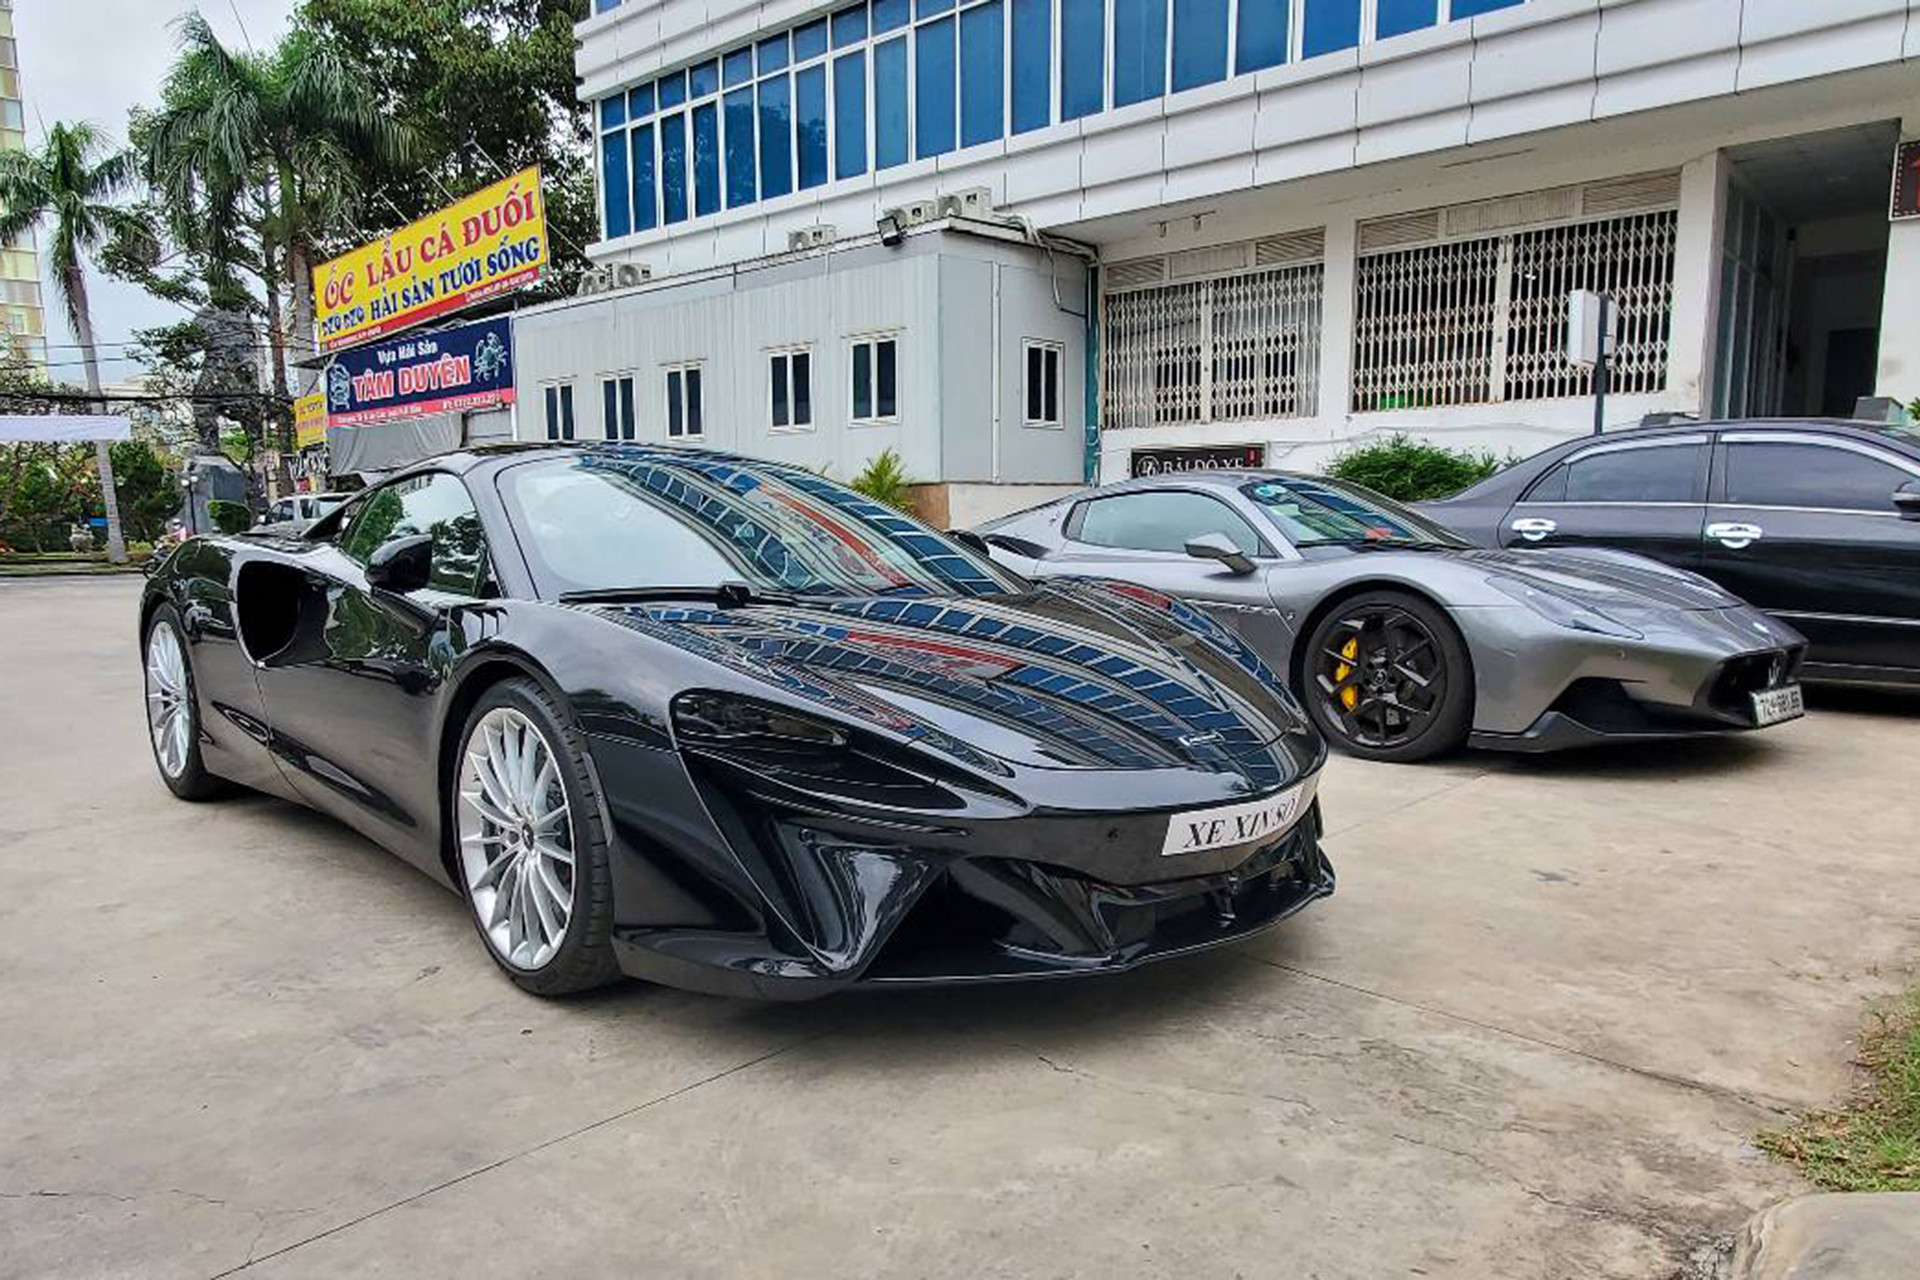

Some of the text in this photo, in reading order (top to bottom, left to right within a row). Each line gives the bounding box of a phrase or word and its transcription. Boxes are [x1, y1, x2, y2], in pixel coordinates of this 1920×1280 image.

[419, 223, 455, 263] CÁ
[462, 183, 535, 247] ĐUỐI
[487, 235, 540, 276] SỐNG
[352, 353, 472, 402] TÂM DUYÊN
[1183, 818, 1226, 848] XE
[1230, 804, 1276, 840] XIN
